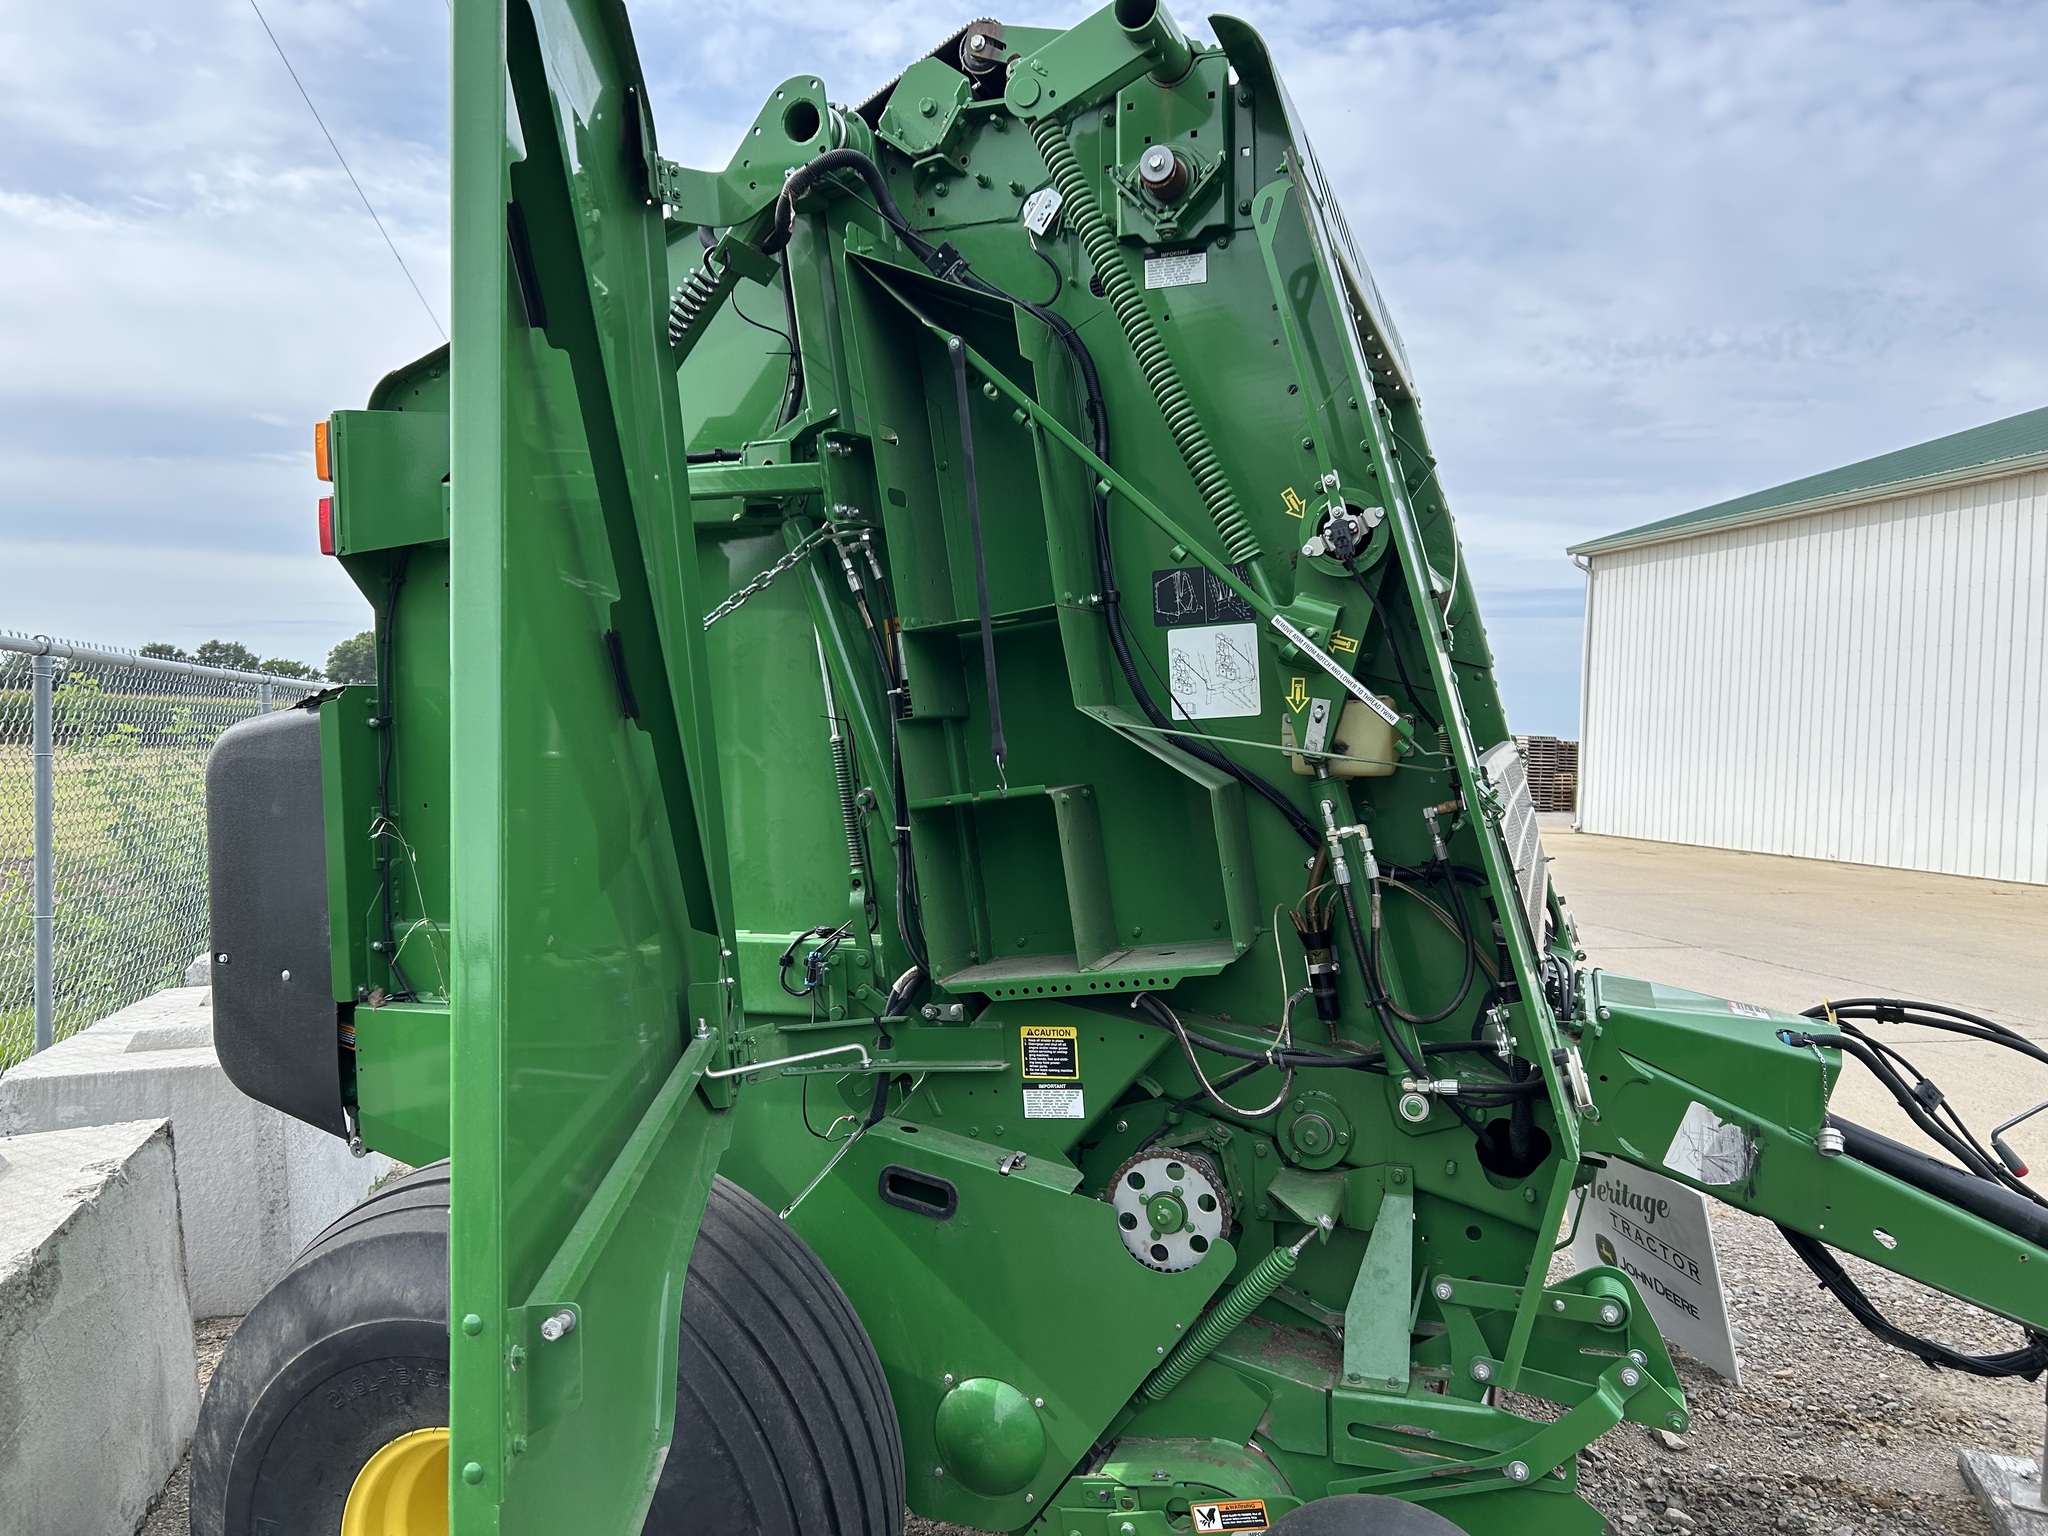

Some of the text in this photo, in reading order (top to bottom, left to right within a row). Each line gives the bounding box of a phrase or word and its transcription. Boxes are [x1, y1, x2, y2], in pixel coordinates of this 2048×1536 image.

[1160, 249, 1190, 258] IMPORTANT
[1274, 617, 1397, 722] REMOVE ARM FROM NOTCH AND LOWER TO THREAD TWINE
[1033, 1028, 1071, 1037] CAUTION
[1609, 1211, 1701, 1282] TRACTOR
[1620, 1257, 1701, 1320] JOHN DEERE
